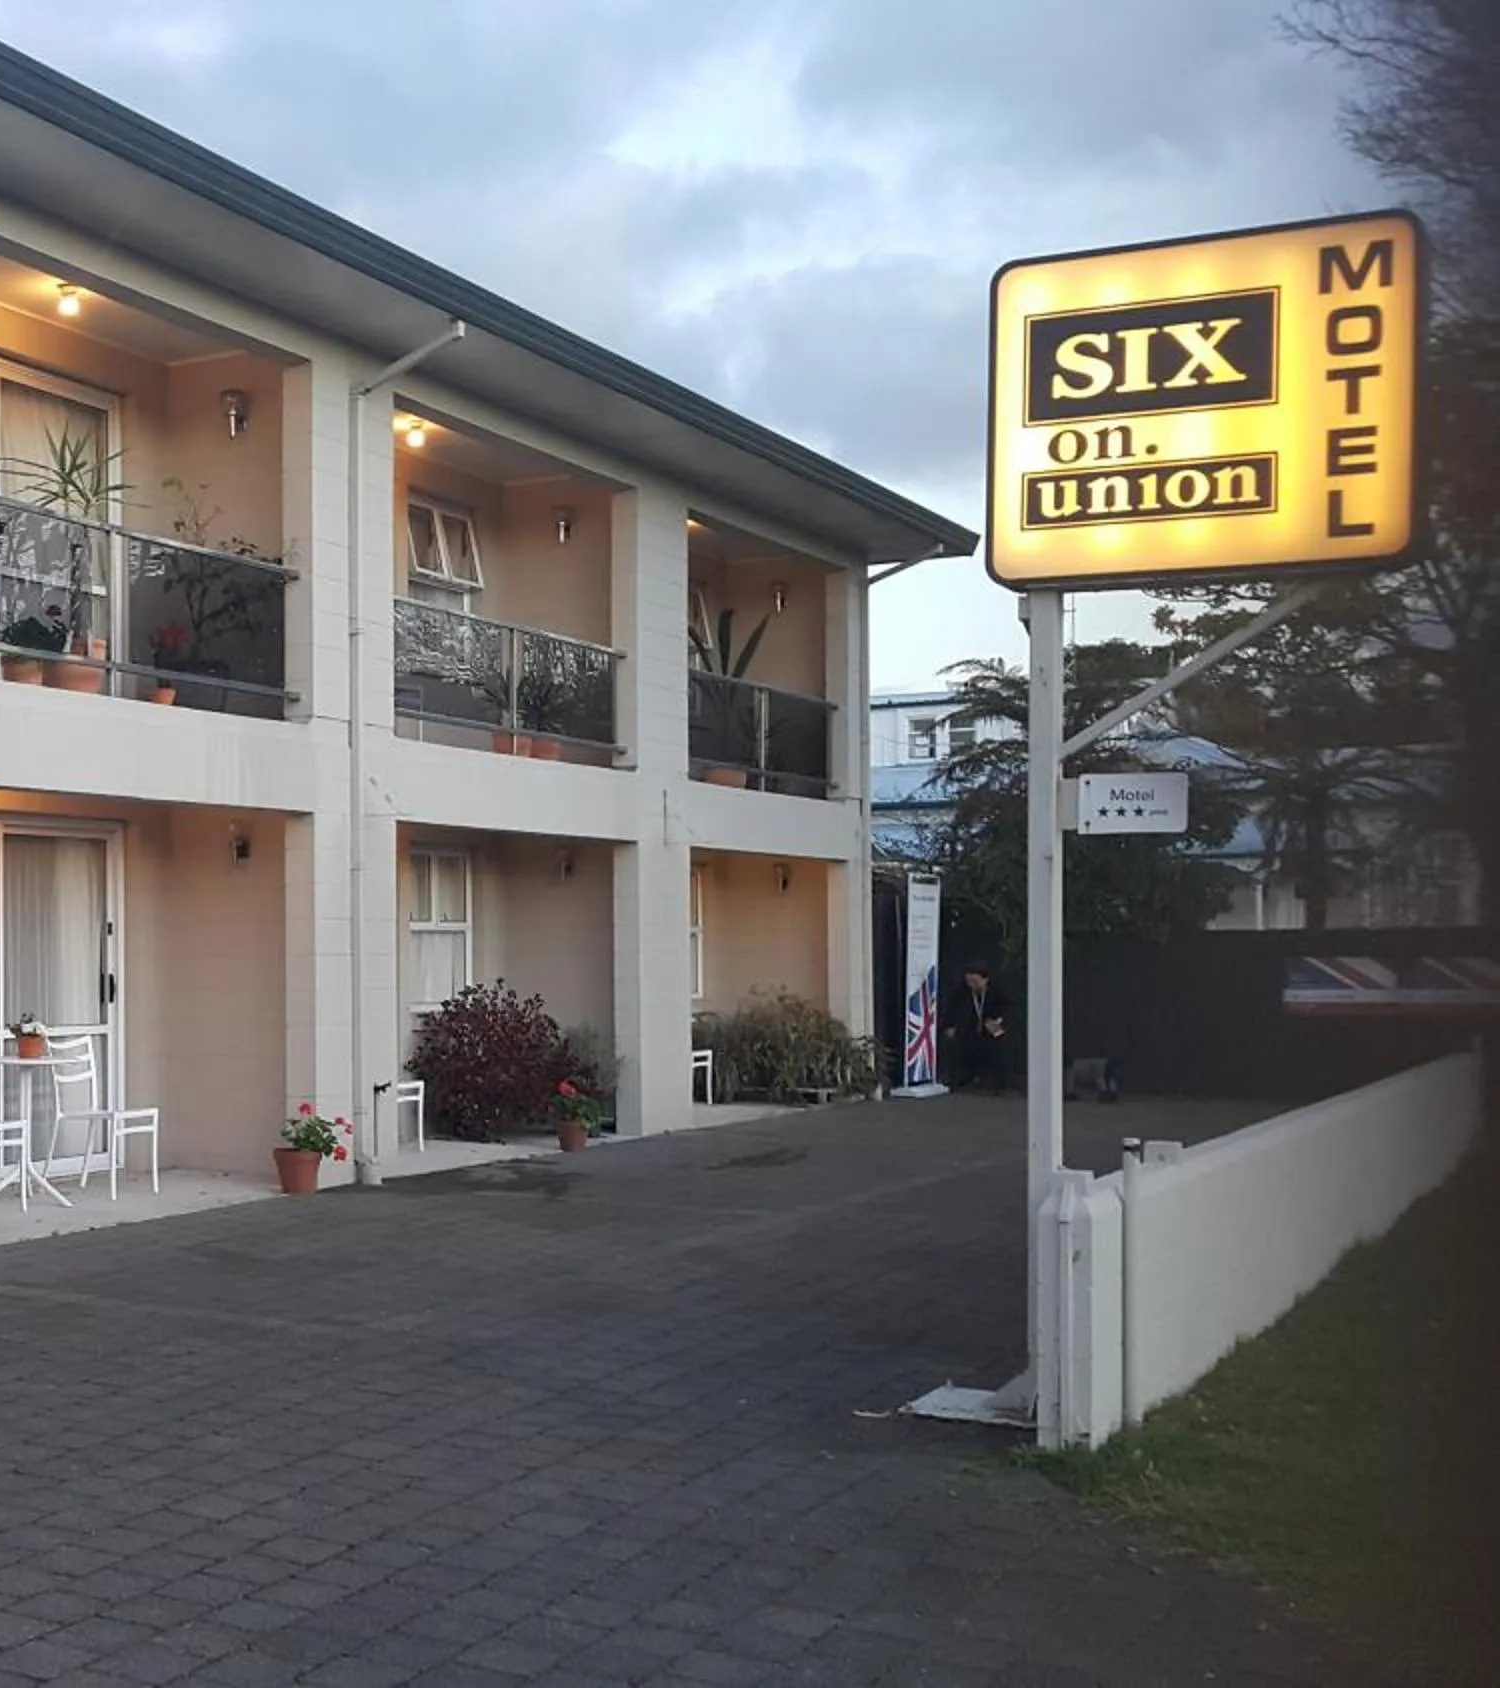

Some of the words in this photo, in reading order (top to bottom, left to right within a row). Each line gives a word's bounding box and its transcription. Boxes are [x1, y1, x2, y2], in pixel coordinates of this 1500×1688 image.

[1052, 317, 1247, 400] SIX
[1318, 239, 1394, 538] MOTEL
[1037, 464, 1261, 518] union
[1109, 788, 1155, 801] Motel
